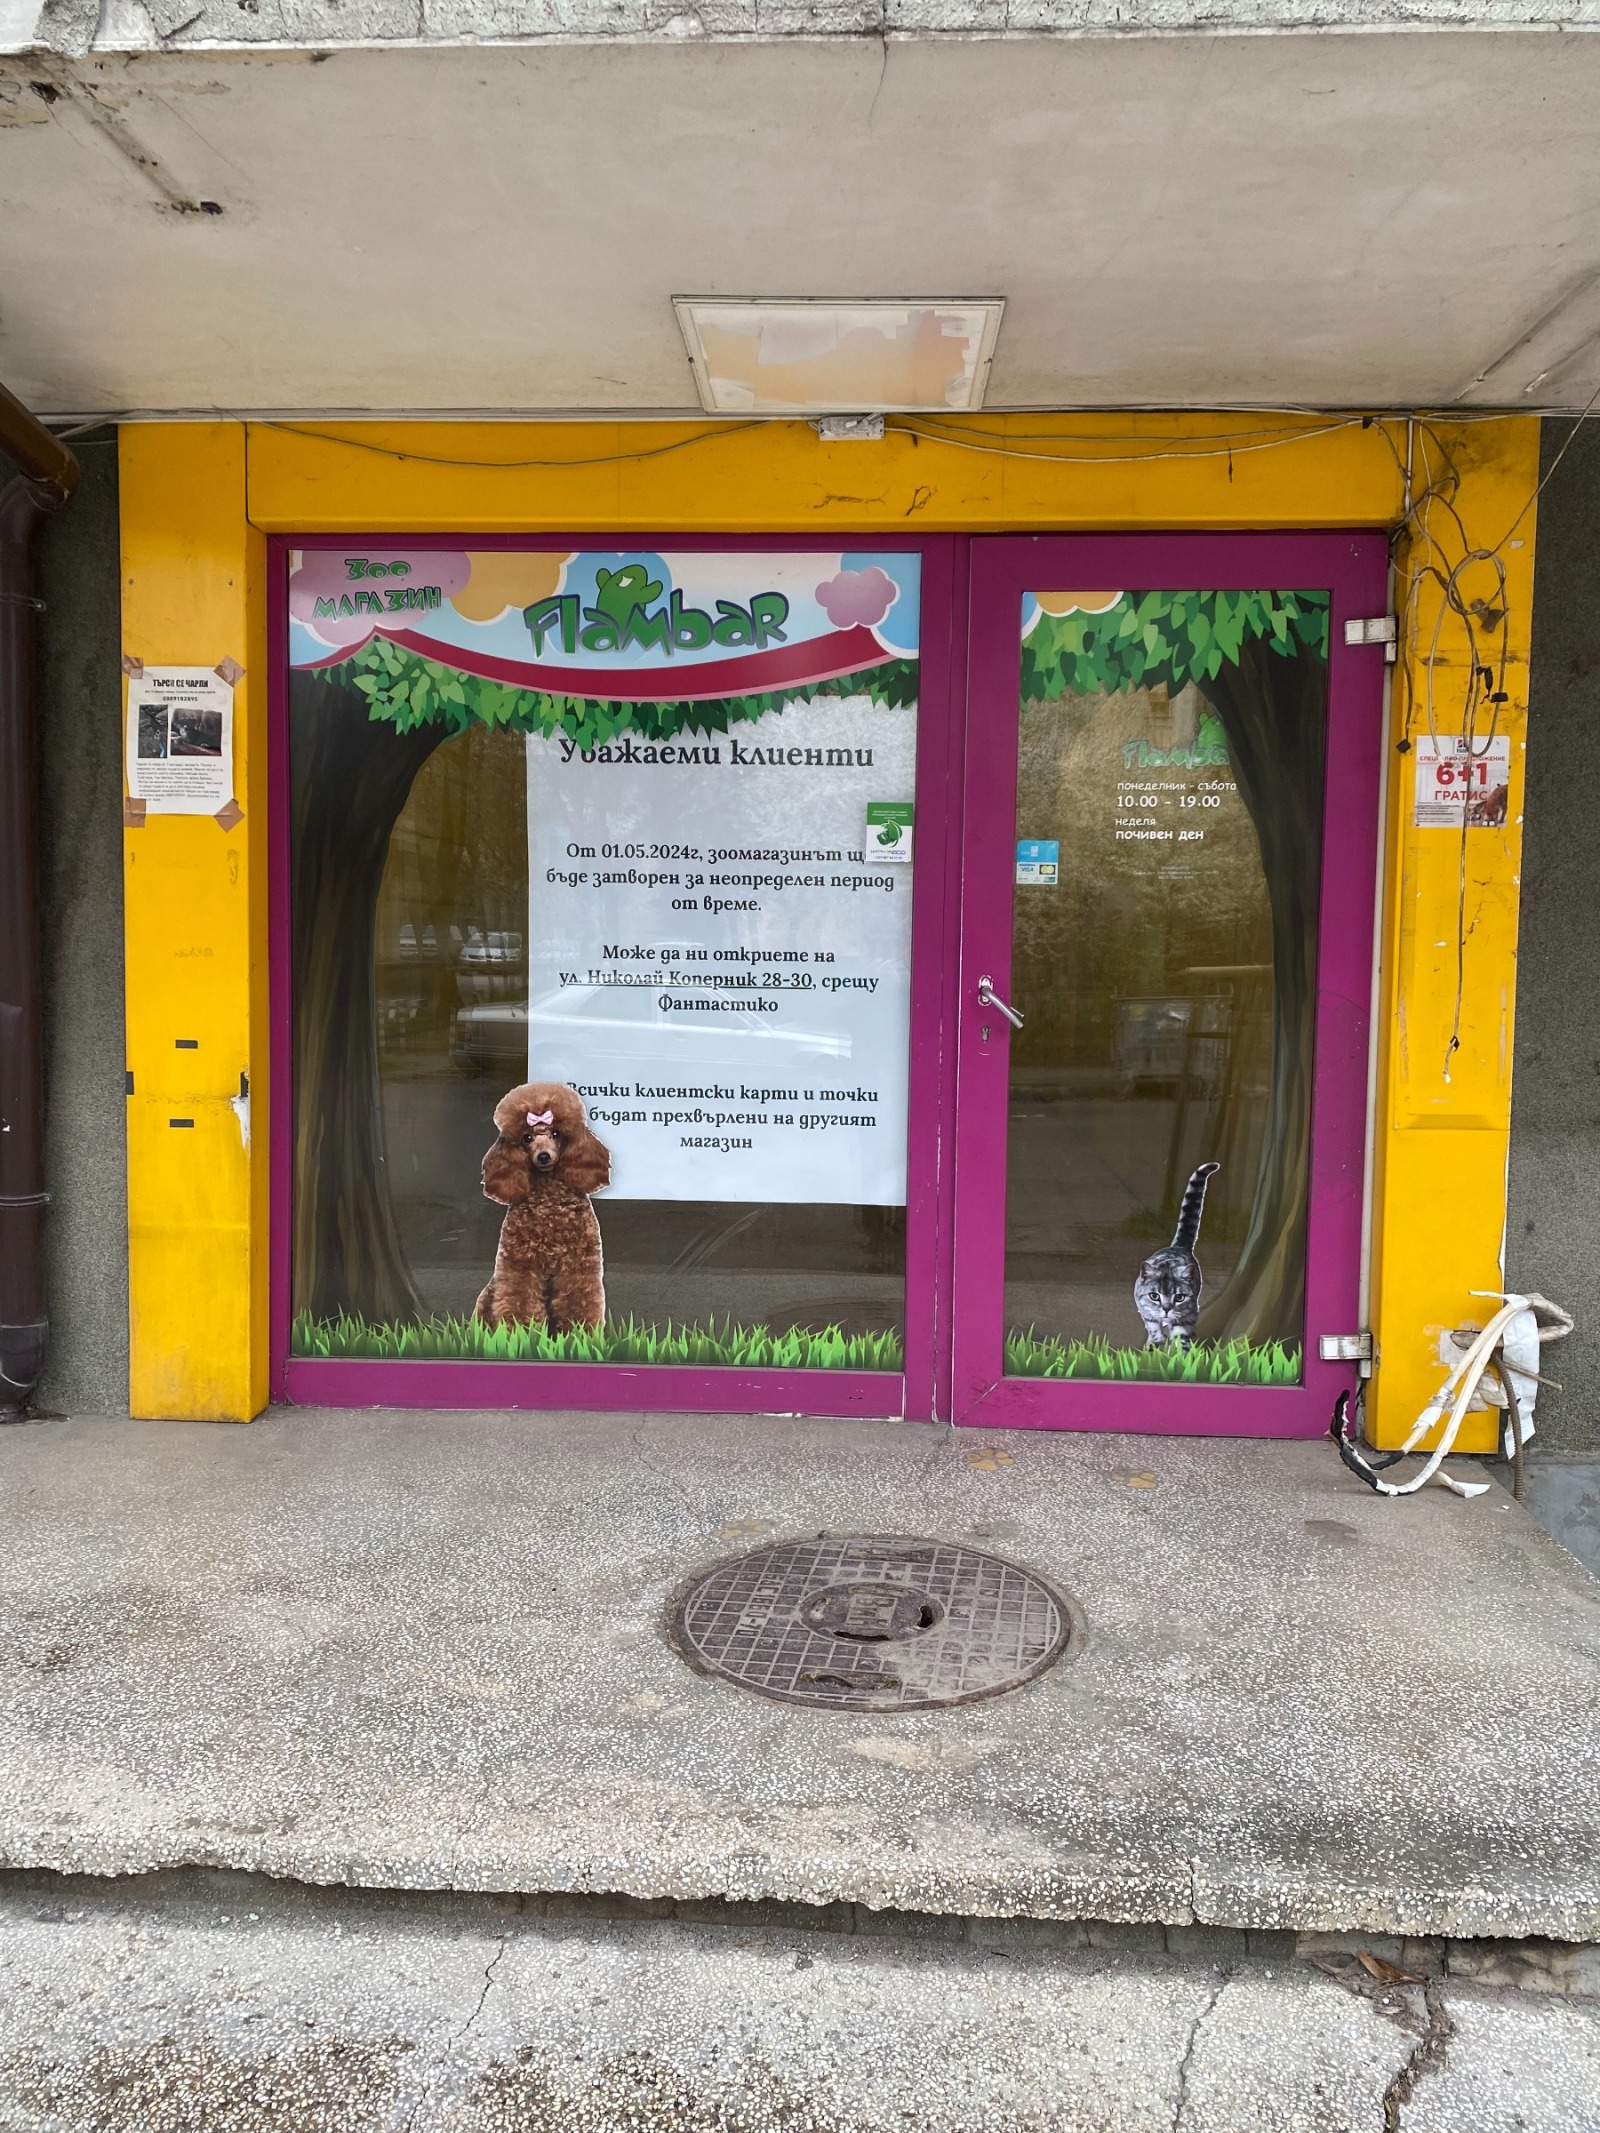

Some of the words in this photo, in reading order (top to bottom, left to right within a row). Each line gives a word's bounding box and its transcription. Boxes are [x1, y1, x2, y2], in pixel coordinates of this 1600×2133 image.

[312, 586, 441, 621] МАГАЗИН
[153, 679, 175, 687] ТЪРСИ
[176, 679, 185, 687] СЕ
[185, 679, 209, 688] ЧАРЛИ
[558, 737, 721, 765] Уважаеми
[730, 739, 874, 767] клиенти
[1436, 761, 1487, 785] 6+1
[1117, 782, 1186, 791] понеделник
[1197, 780, 1237, 791] събота
[1116, 795, 1158, 807] 10.00
[1179, 795, 1221, 808] 19.00
[1435, 790, 1488, 801] ГРАТИС
[1115, 818, 1156, 827] неделя
[1115, 830, 1173, 840] почивен
[1178, 830, 1204, 841] ден
[566, 843, 597, 858] От
[601, 844, 704, 862] 01.05.2024г,
[708, 848, 843, 865] зоомагазинът
[847, 850, 867, 865] щ
[546, 868, 588, 887] бъде
[593, 869, 681, 888] затворен
[685, 874, 704, 889] за
[710, 874, 826, 890] неопределен
[831, 876, 895, 892] период
[671, 899, 699, 910] от
[704, 896, 762, 915] време.
[602, 945, 656, 960] Може
[661, 949, 681, 964] да
[686, 949, 709, 961] ни
[713, 947, 809, 965] откриете
[814, 951, 835, 962] на
[559, 972, 582, 987] ул.
[588, 970, 663, 985] Николай
[669, 971, 757, 990] Коперник
[762, 972, 816, 989] 28-30,
[822, 976, 880, 993] срещу
[658, 994, 779, 1012] Фантастико
[635, 1082, 736, 1099] клиентски
[740, 1085, 799, 1104] карти
[803, 1089, 815, 1100] и
[819, 1087, 879, 1102] точки
[589, 1105, 648, 1126] бъдат
[652, 1109, 769, 1128] прехвърлени
[773, 1113, 794, 1124] на
[799, 1114, 877, 1129] другият
[679, 1136, 753, 1152] магазин
